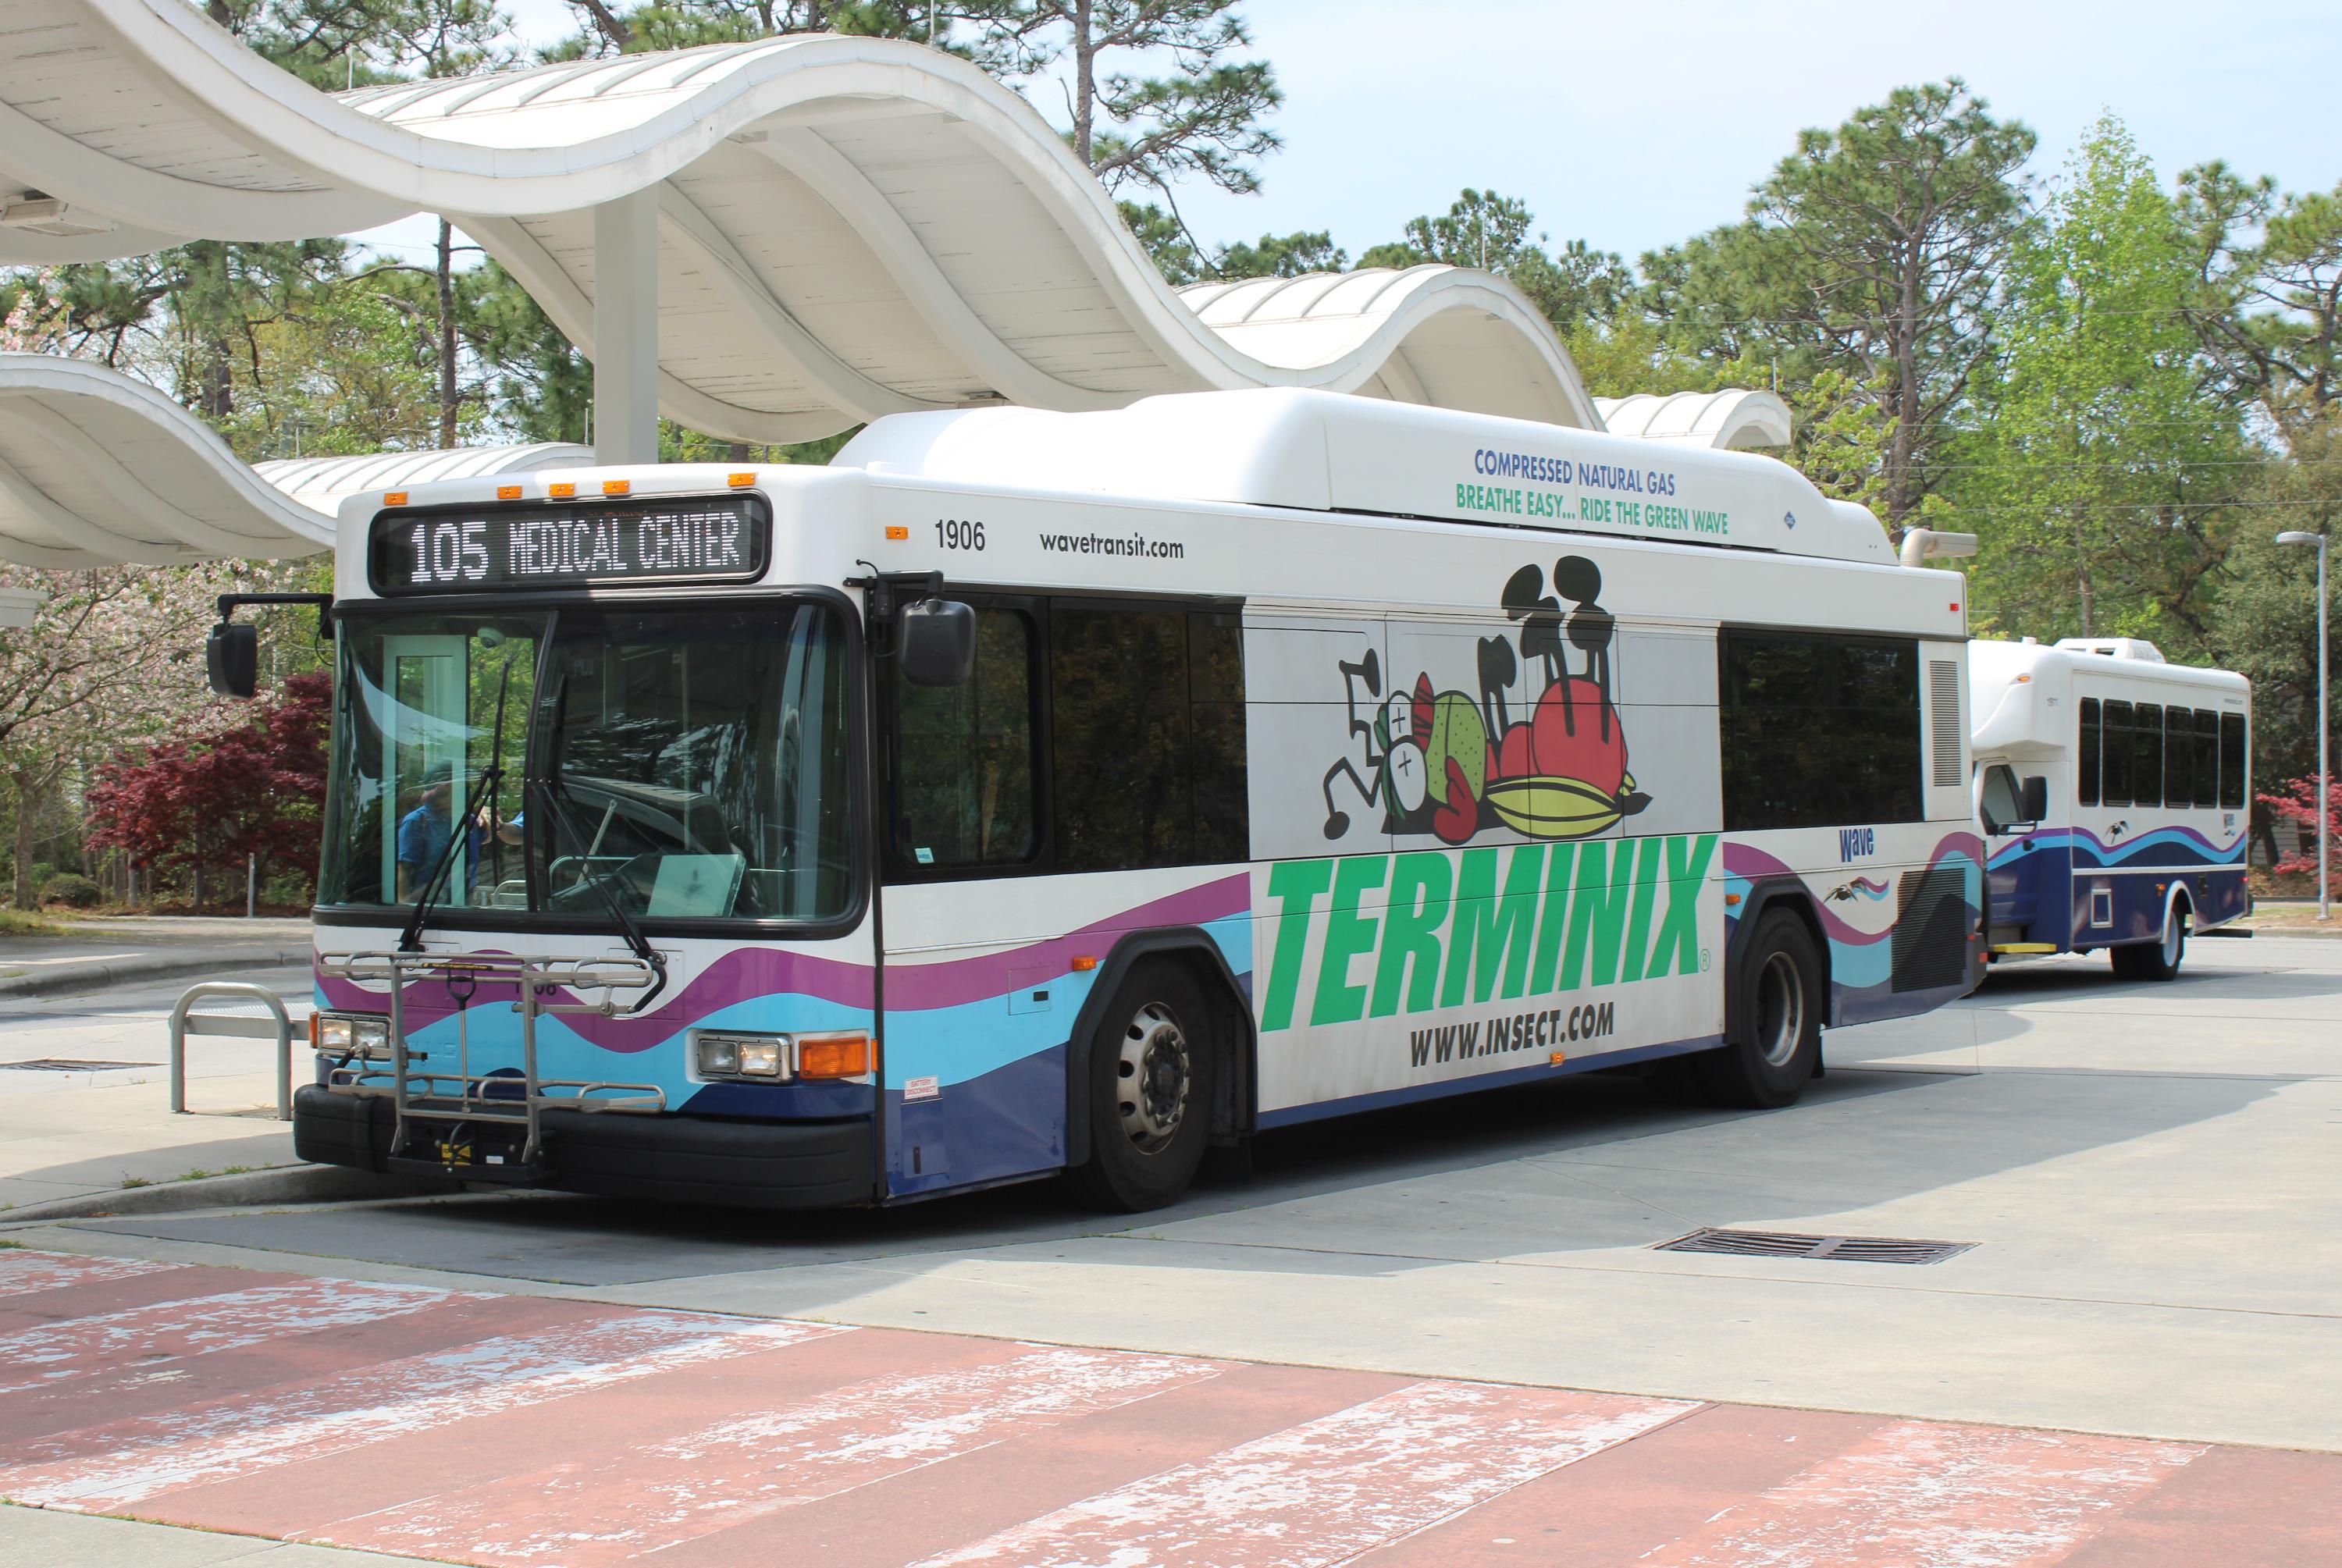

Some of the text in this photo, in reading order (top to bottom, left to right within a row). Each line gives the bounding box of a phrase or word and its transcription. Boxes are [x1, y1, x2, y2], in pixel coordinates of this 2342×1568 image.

[1475, 449, 1675, 496] COMPRESSED NATURAL GAS
[935, 519, 986, 551] 1906
[1456, 483, 1729, 535] BREATHE EASY... RIDE THE GREEN WAVE
[411, 512, 741, 583] 105 MEDICAL CENTER
[1039, 532, 1184, 559] wavetransit.com
[1260, 834, 1719, 1033] TERMINIX
[1410, 1001, 1614, 1068] WWW.INSECT.COM
